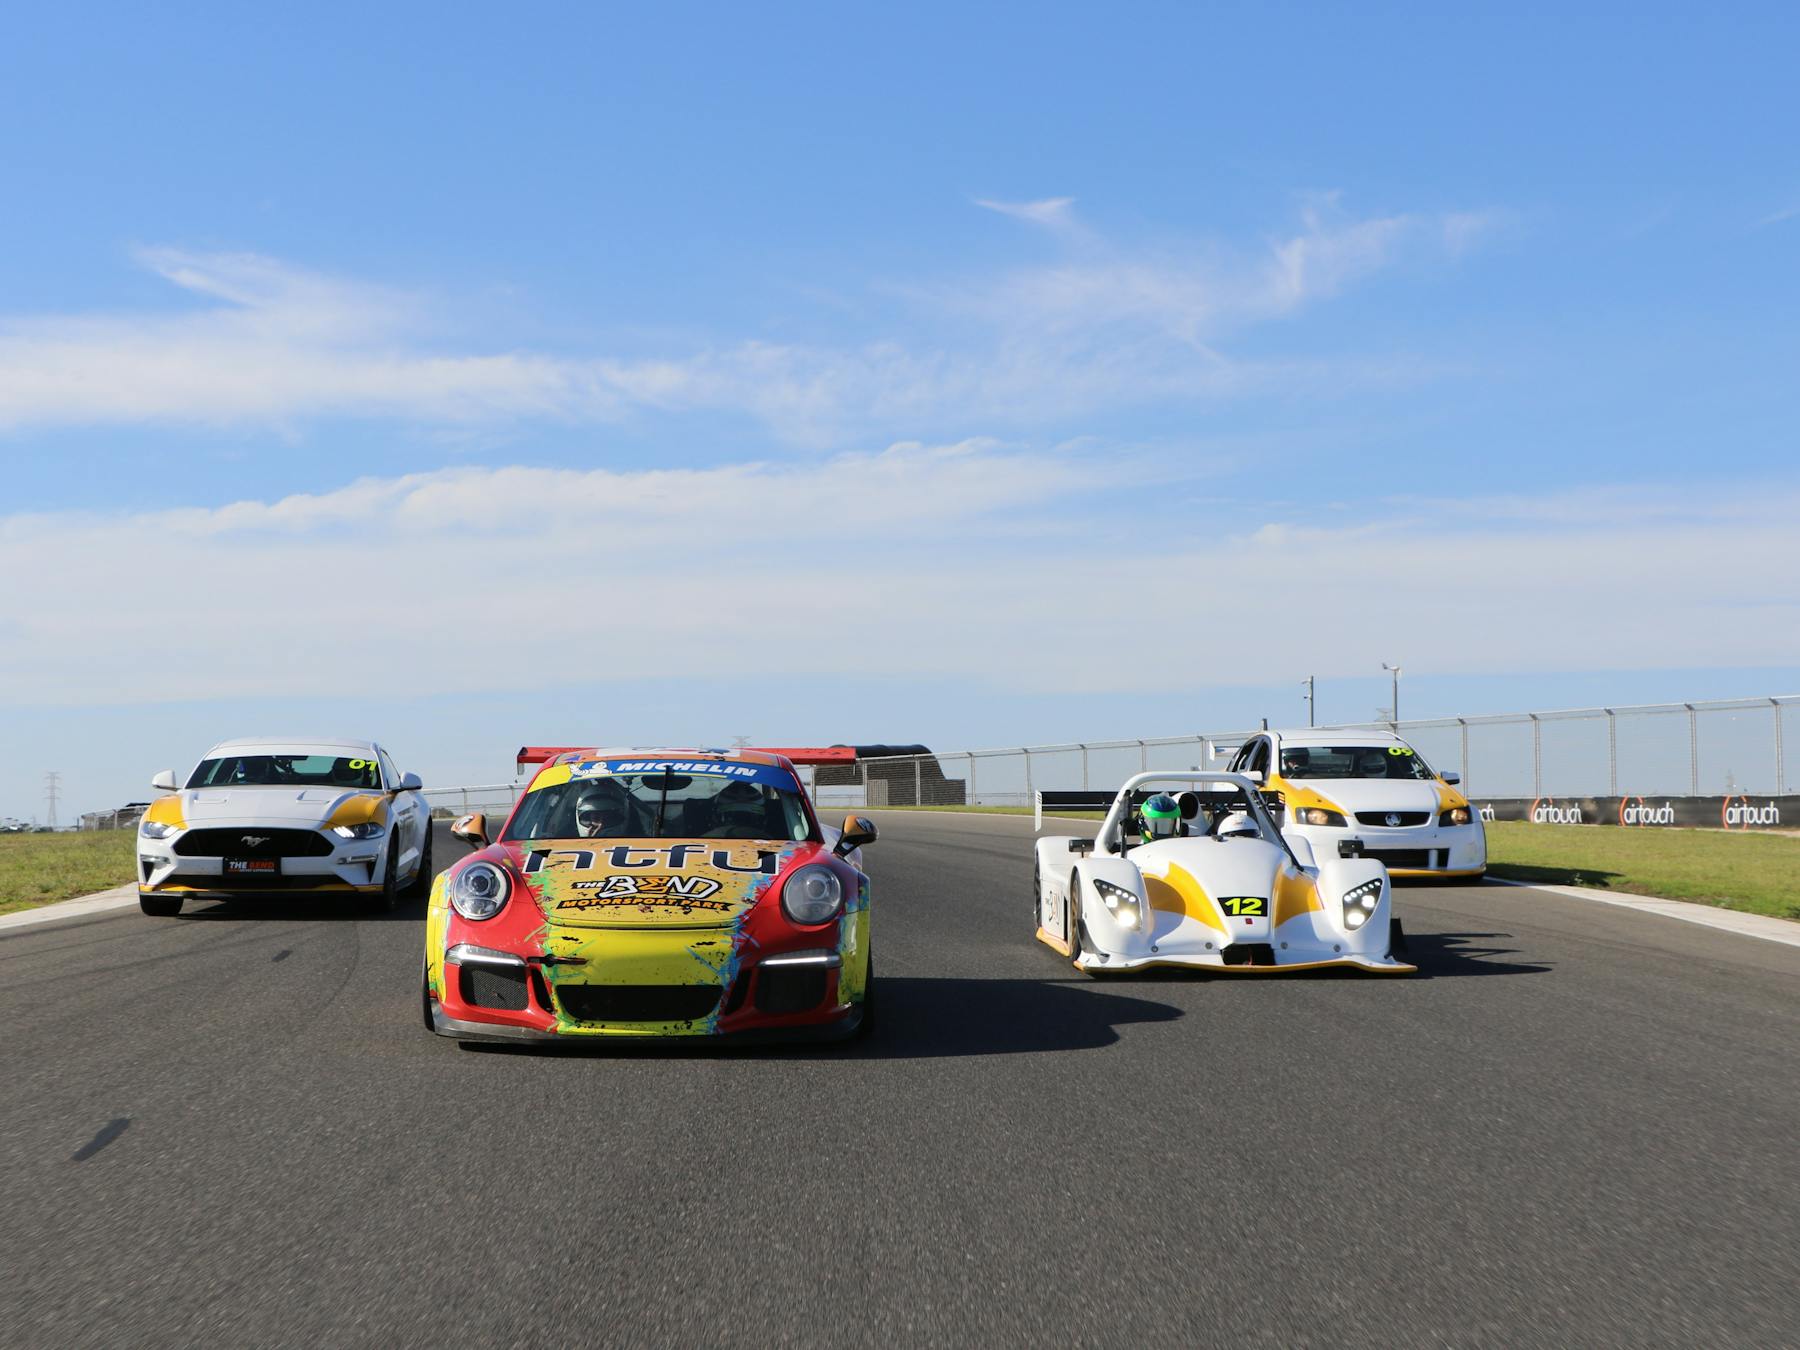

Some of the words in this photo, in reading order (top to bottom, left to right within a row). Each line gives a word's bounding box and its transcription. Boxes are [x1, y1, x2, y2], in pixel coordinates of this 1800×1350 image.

[348, 759, 377, 771] 01
[616, 762, 758, 777] MICHELIN
[1624, 802, 1674, 824] airtouch
[1726, 801, 1779, 824] airtouch
[229, 861, 247, 869] THE
[575, 881, 605, 890] THE
[598, 876, 720, 899] BEND
[561, 897, 678, 908] MOTORSPORT
[679, 898, 729, 910] PARK
[1224, 897, 1263, 915] 12
